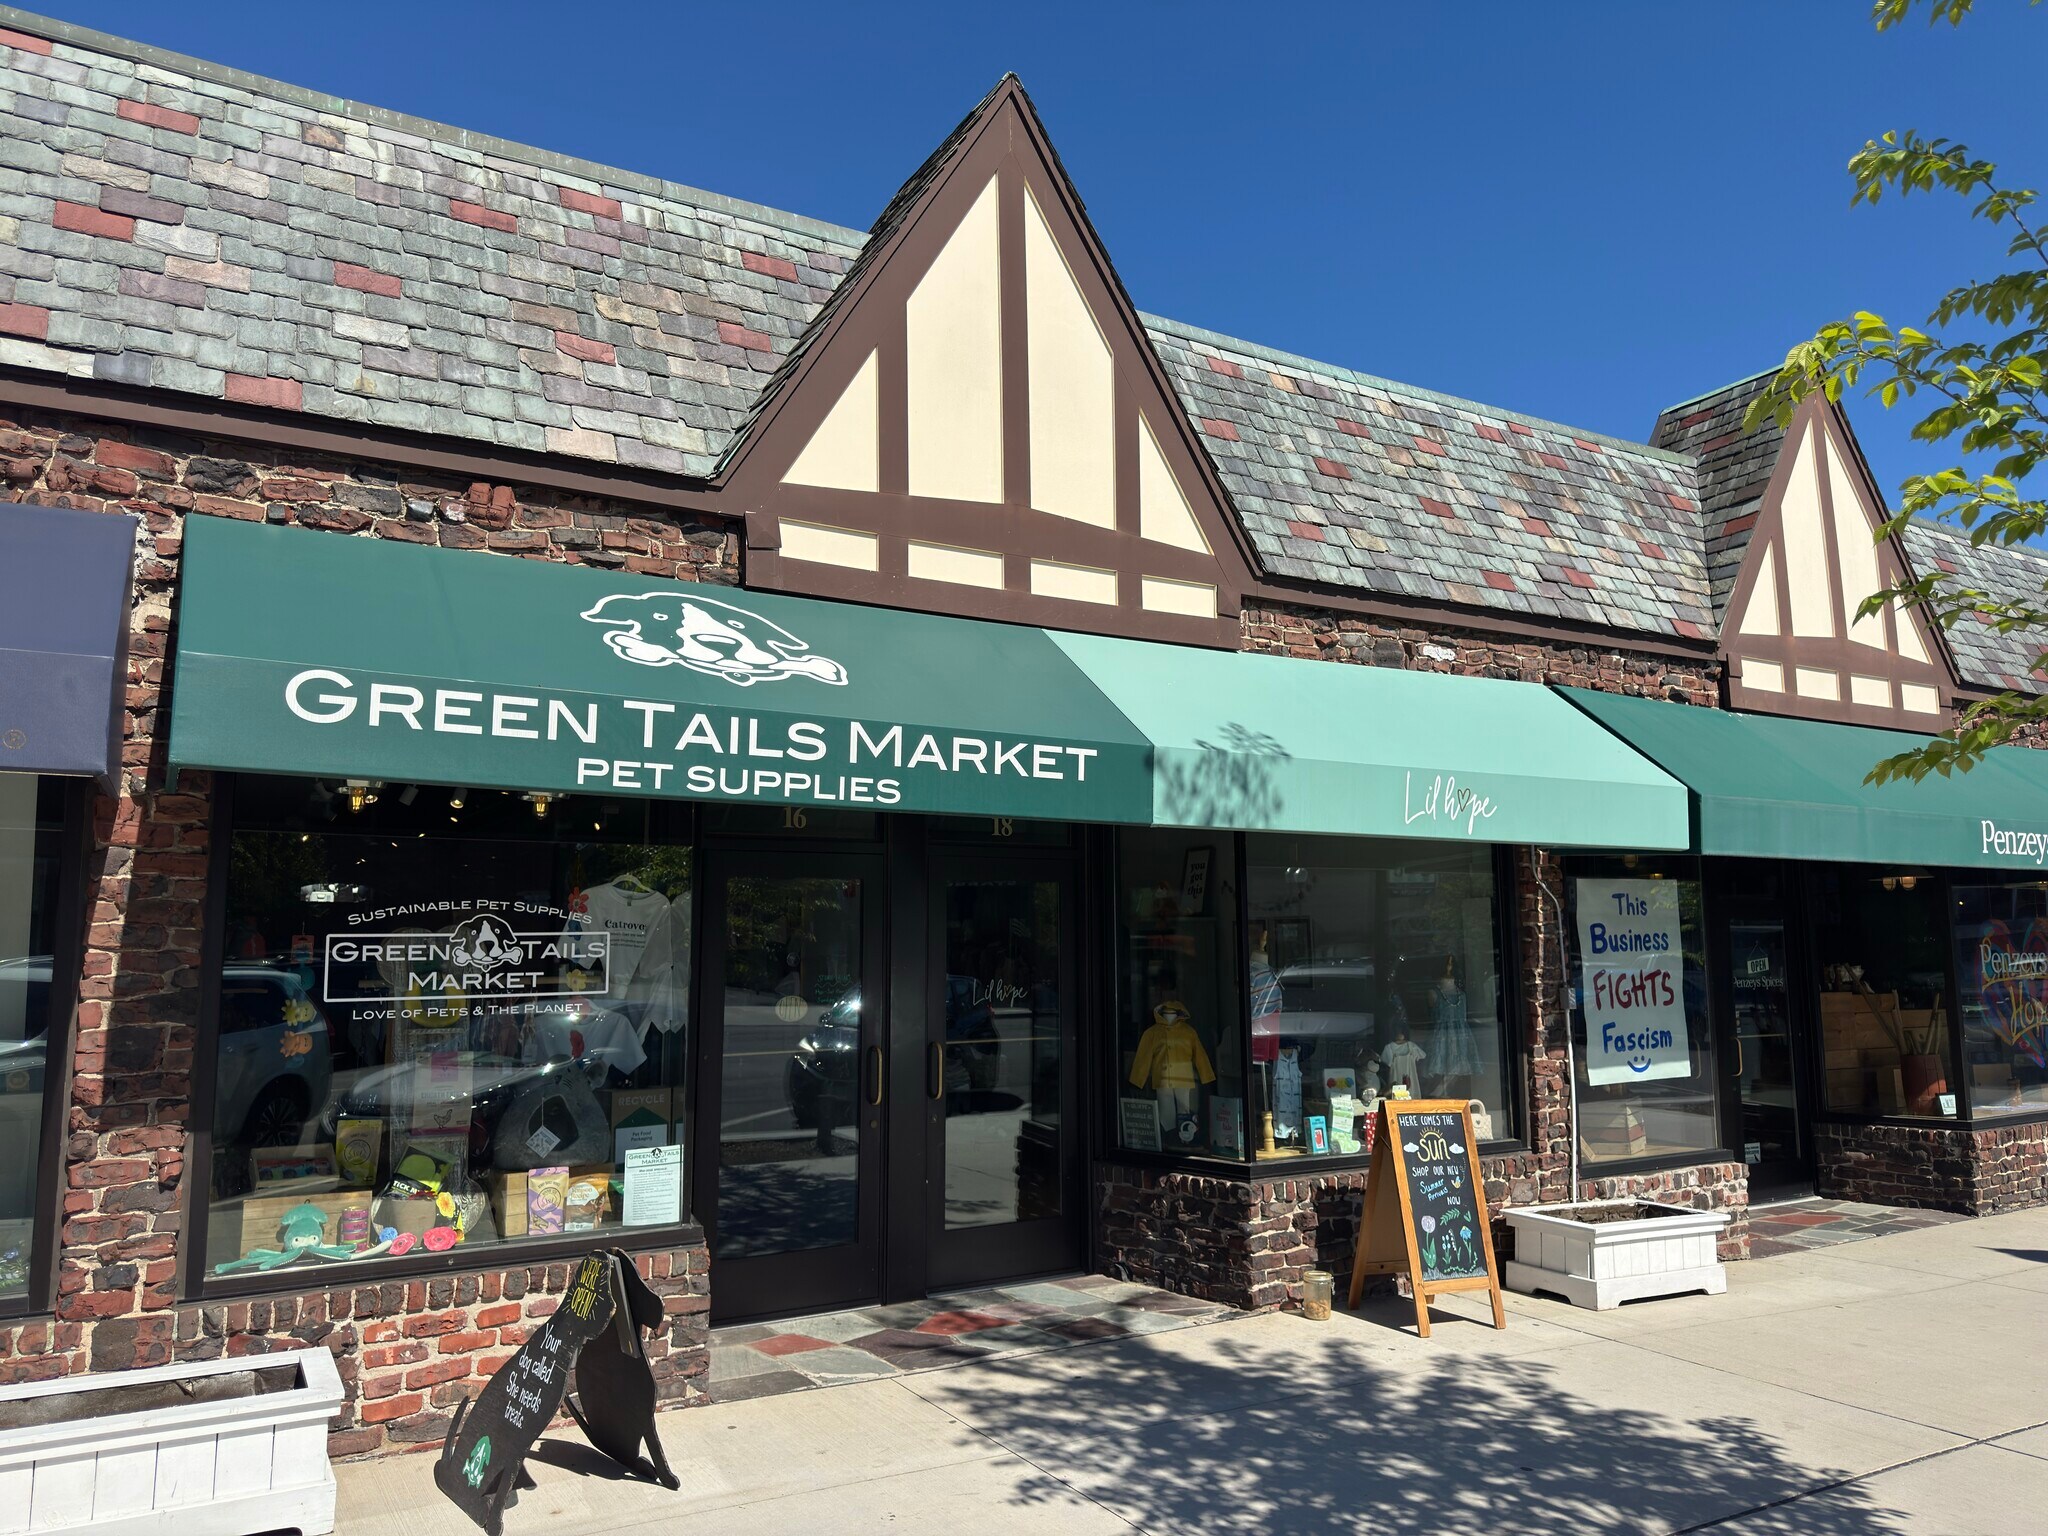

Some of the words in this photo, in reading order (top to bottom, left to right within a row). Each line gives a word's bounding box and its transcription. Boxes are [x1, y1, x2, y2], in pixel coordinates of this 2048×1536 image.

[285, 669, 598, 744] GREEN
[623, 700, 827, 762] TAILS
[849, 721, 1098, 782] MARKET
[576, 757, 674, 790] PET
[686, 765, 902, 804] SUPPLIES
[1405, 770, 1441, 825] Lil
[783, 806, 807, 829] 16
[991, 817, 1013, 837] 18
[1981, 820, 2048, 865] Penzey
[348, 900, 471, 925] SUSTAINABLE
[513, 901, 593, 924] SUPPLIES
[1611, 893, 1648, 916] This
[1589, 922, 1669, 954] Business
[331, 941, 450, 962] GREEN
[519, 940, 606, 960] TAILS
[1750, 958, 1767, 972] OPEN
[408, 971, 545, 991] MARKET
[1593, 969, 1675, 1011] FIGHTS
[1761, 976, 1784, 990] Spices
[352, 1009, 396, 1020] LOVE
[427, 1007, 469, 1017] PETS
[472, 1006, 484, 1016] &
[488, 1004, 519, 1015] THE
[524, 1003, 583, 1013] PLANET
[1602, 1022, 1673, 1054] Fascism
[618, 1094, 665, 1106] RECYCLE
[1399, 1115, 1418, 1127] HERE
[1420, 1115, 1440, 1126] COMES
[1442, 1115, 1454, 1125] THE
[641, 1157, 668, 1165] MARKET
[1412, 1165, 1429, 1177] SHOP
[1433, 1165, 1445, 1176] OUR
[393, 1180, 410, 1191] TICK
[1420, 1178, 1444, 1195] Summer
[1447, 1196, 1461, 1205] NOW
[571, 1286, 597, 1321] OPEN!
[540, 1323, 562, 1354] Your
[518, 1345, 532, 1380] dog
[531, 1355, 556, 1385] called.
[506, 1371, 520, 1399] She
[518, 1387, 542, 1413] needs
